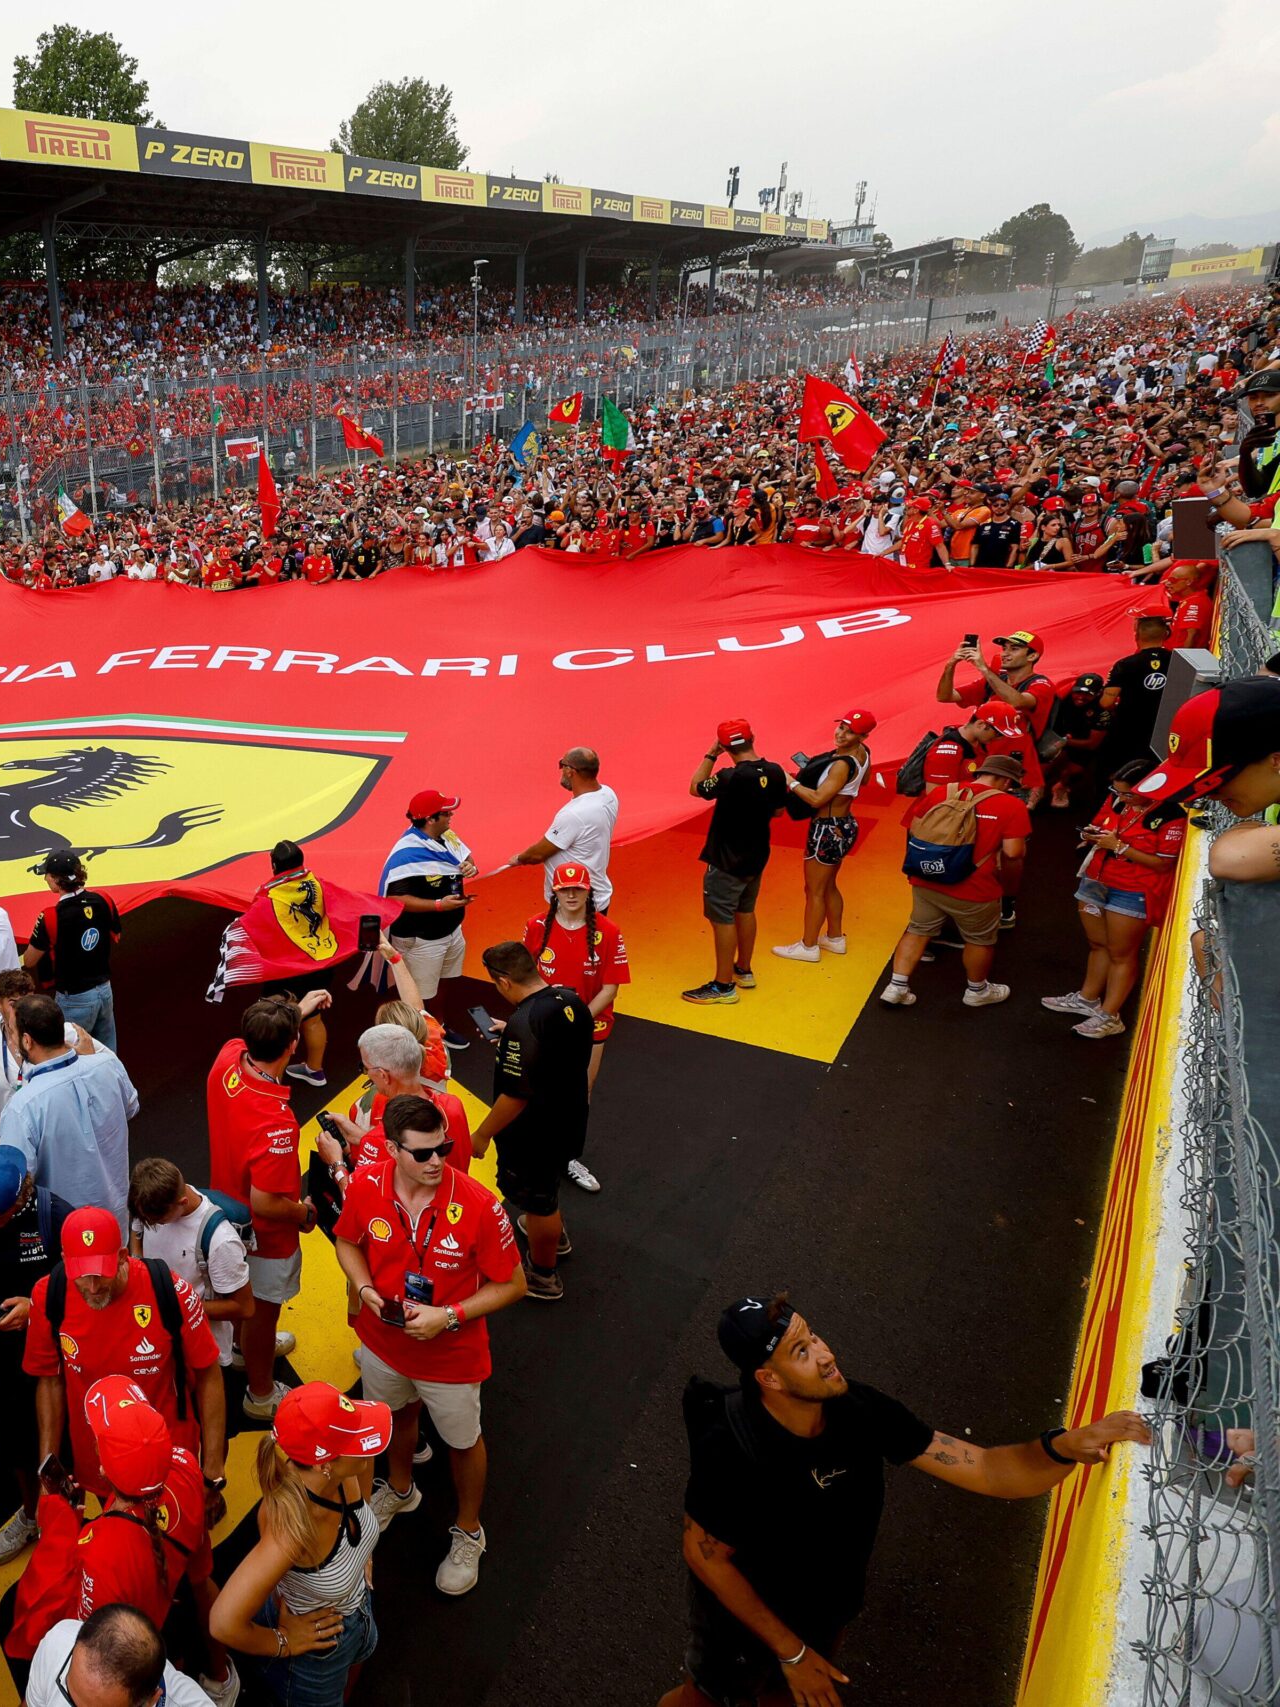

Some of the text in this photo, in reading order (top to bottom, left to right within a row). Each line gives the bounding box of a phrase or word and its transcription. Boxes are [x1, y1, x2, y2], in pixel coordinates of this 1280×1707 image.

[26, 120, 111, 161] PIRELLI
[144, 142, 245, 170] P ZERO
[270, 152, 326, 183] PIRELLI
[348, 167, 417, 190] P ZERO
[434, 175, 474, 200] PIRELLI
[489, 186, 540, 203] P ZERO
[553, 188, 582, 210] PIRELLI
[593, 197, 631, 213] P ZERO
[640, 201, 664, 219] PIRELLI
[680, 209, 703, 221] ZERO
[741, 216, 759, 227] ZERO
[1191, 259, 1237, 272] PIRELLI
[97, 645, 518, 677] FERRARI
[552, 607, 913, 671] CLUB
[1146, 674, 1166, 690] hp
[82, 928, 99, 950] hp
[20, 1254, 48, 1263] HONDA
[433, 1246, 464, 1258] Santander
[130, 1353, 161, 1363] Santander
[360, 1433, 382, 1451] 16
